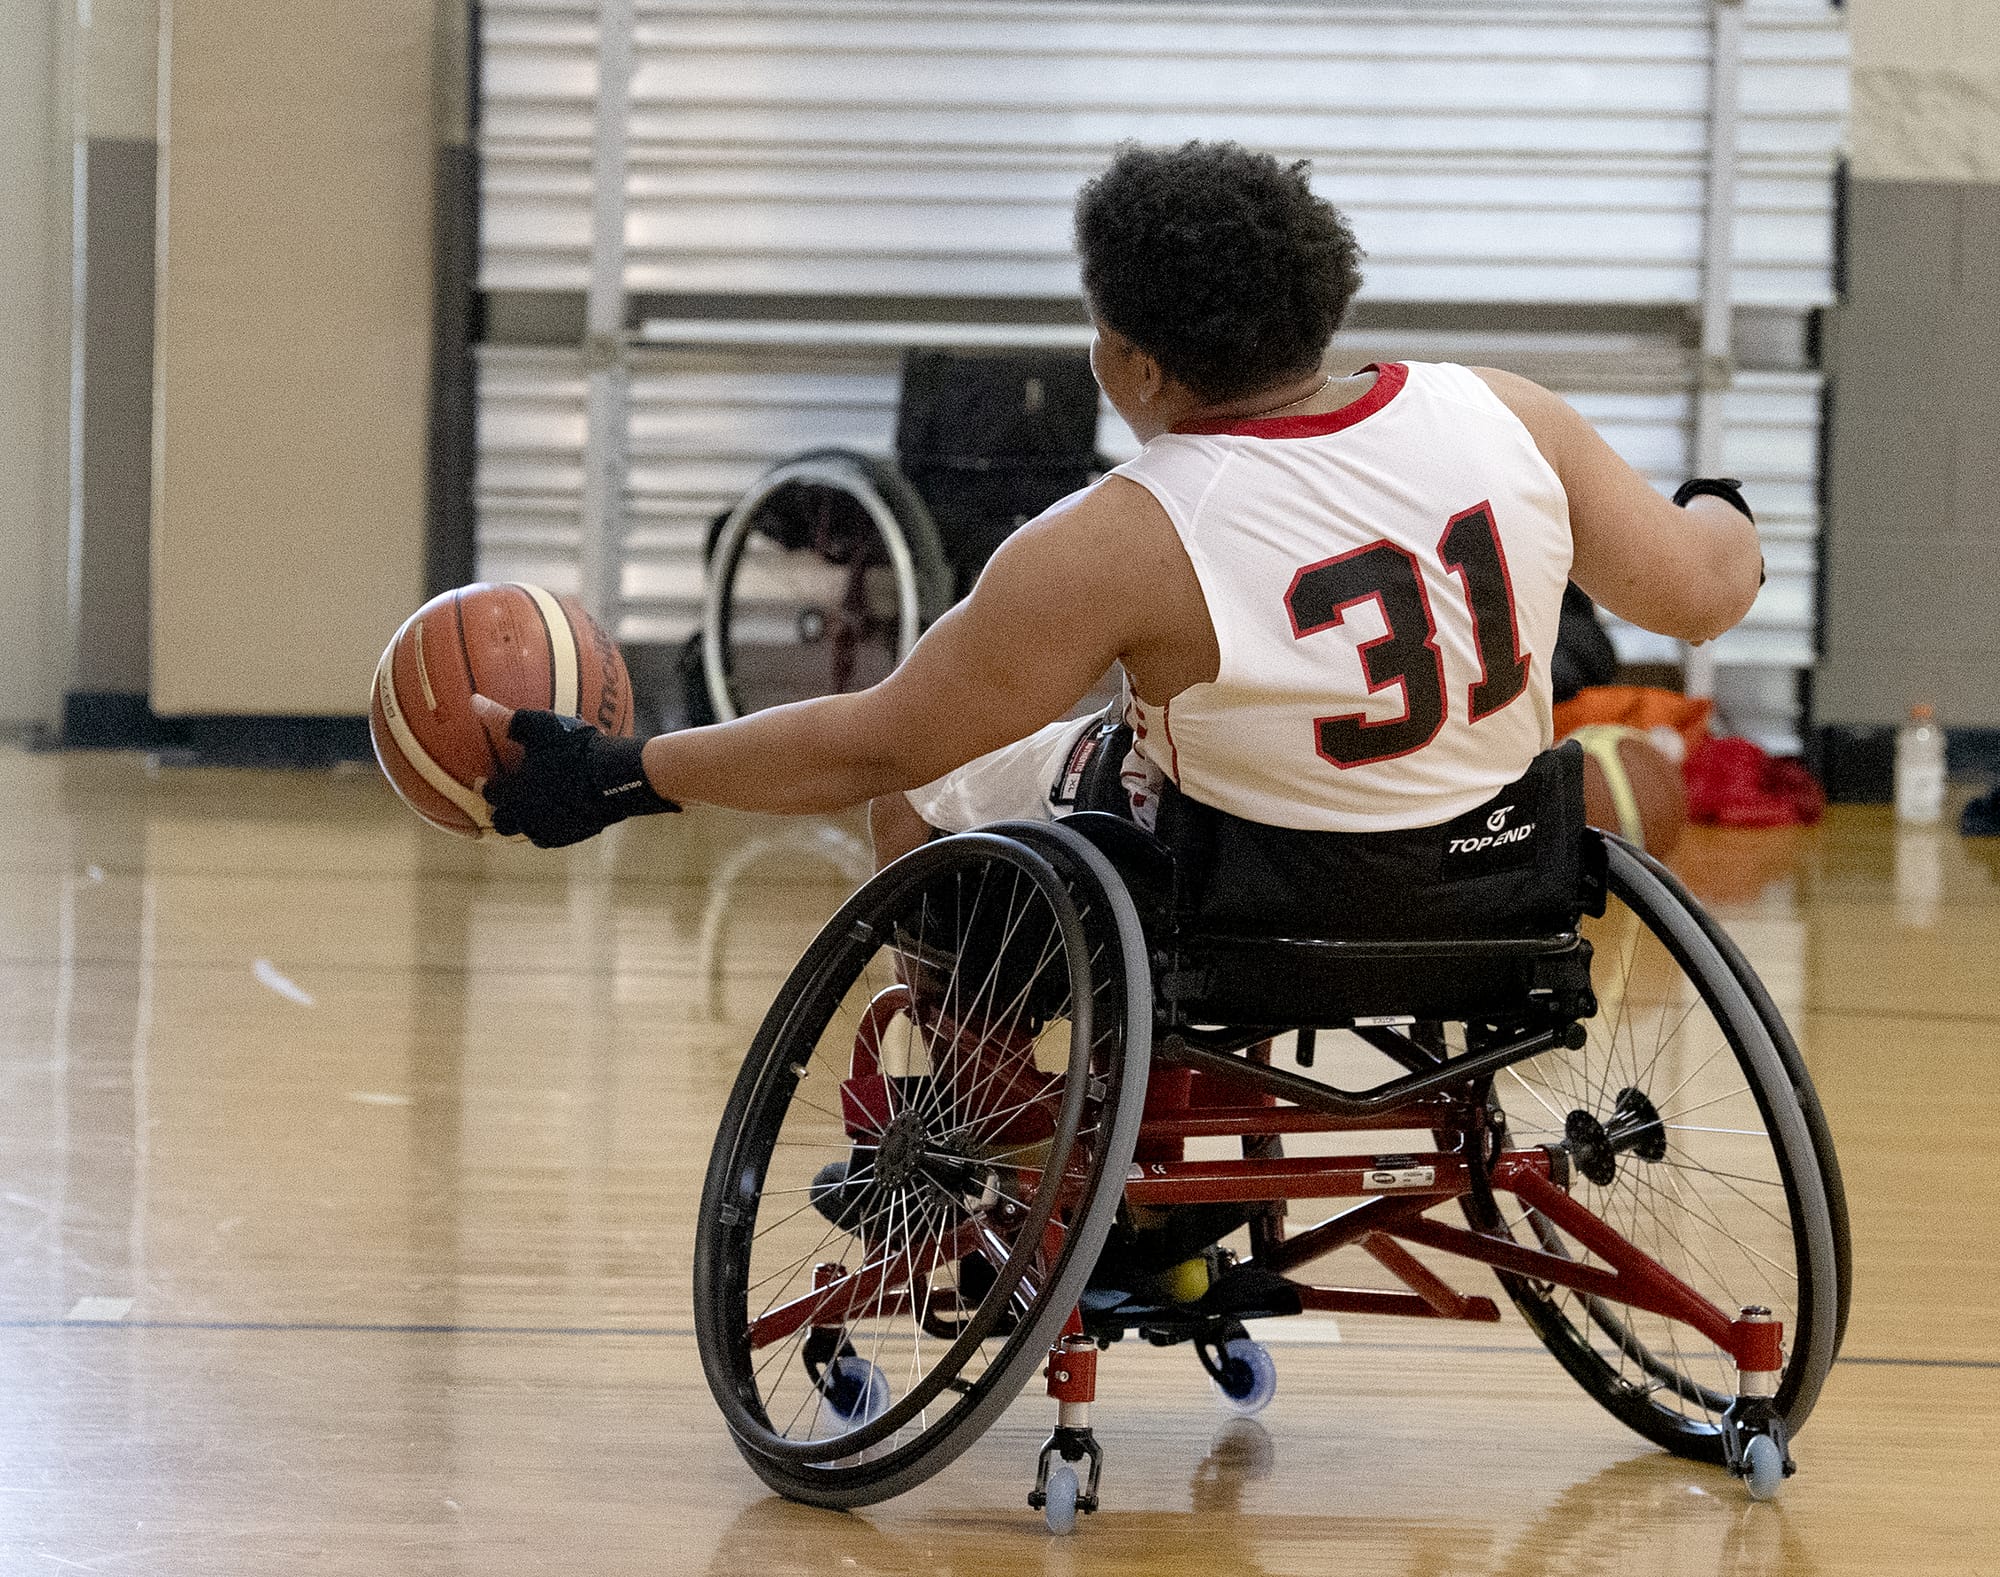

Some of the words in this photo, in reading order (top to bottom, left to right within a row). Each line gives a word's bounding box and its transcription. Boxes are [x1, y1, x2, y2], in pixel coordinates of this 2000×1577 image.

[1284, 499, 1531, 770] 31
[1067, 779, 1078, 793] XL
[1448, 837, 1494, 854] TOP
[1492, 824, 1532, 847] END
